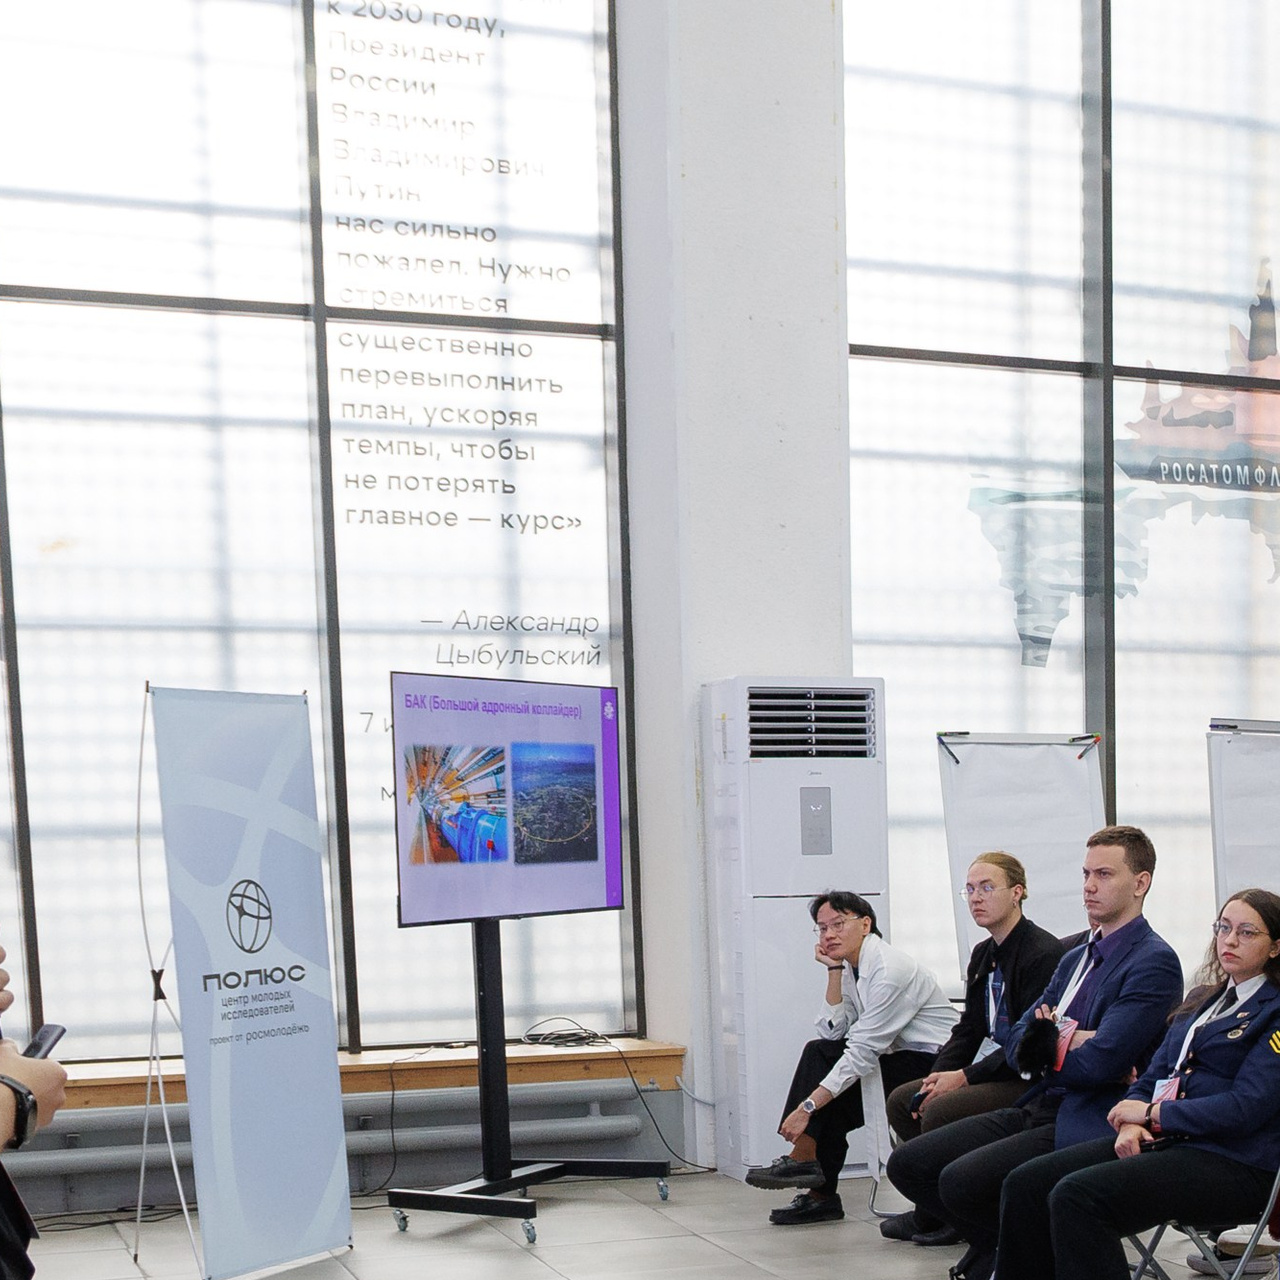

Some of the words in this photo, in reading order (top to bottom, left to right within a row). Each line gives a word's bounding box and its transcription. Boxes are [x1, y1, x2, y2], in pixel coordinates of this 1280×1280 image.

[352, 0, 423, 24] 2030
[432, 12, 506, 38] году,
[328, 30, 486, 66] Президент
[330, 66, 437, 96] России
[334, 175, 422, 202] Путин
[335, 216, 385, 235] нас
[394, 220, 497, 243] сильно
[479, 257, 572, 284] Нужно
[338, 287, 509, 314] стремиться
[338, 331, 533, 359] существенно
[340, 367, 563, 394] перевыполнить
[341, 403, 412, 425] план,
[423, 405, 538, 430] ускоряя
[343, 438, 441, 461] темпы,
[451, 438, 535, 461] чтобы
[345, 474, 377, 490] не
[388, 475, 516, 497] потерять
[345, 508, 458, 528] главное
[501, 512, 582, 534] курс»
[451, 610, 600, 639] Александр
[436, 643, 601, 670] Цыбульский
[404, 693, 427, 709] БАК
[429, 695, 480, 713] (Большой
[481, 700, 531, 715] адронный
[531, 703, 583, 719] коллайдер)
[220, 1000, 295, 1021] исследователей
[221, 994, 249, 1008] центр
[251, 990, 292, 1003] молодых
[209, 1035, 234, 1046] проект
